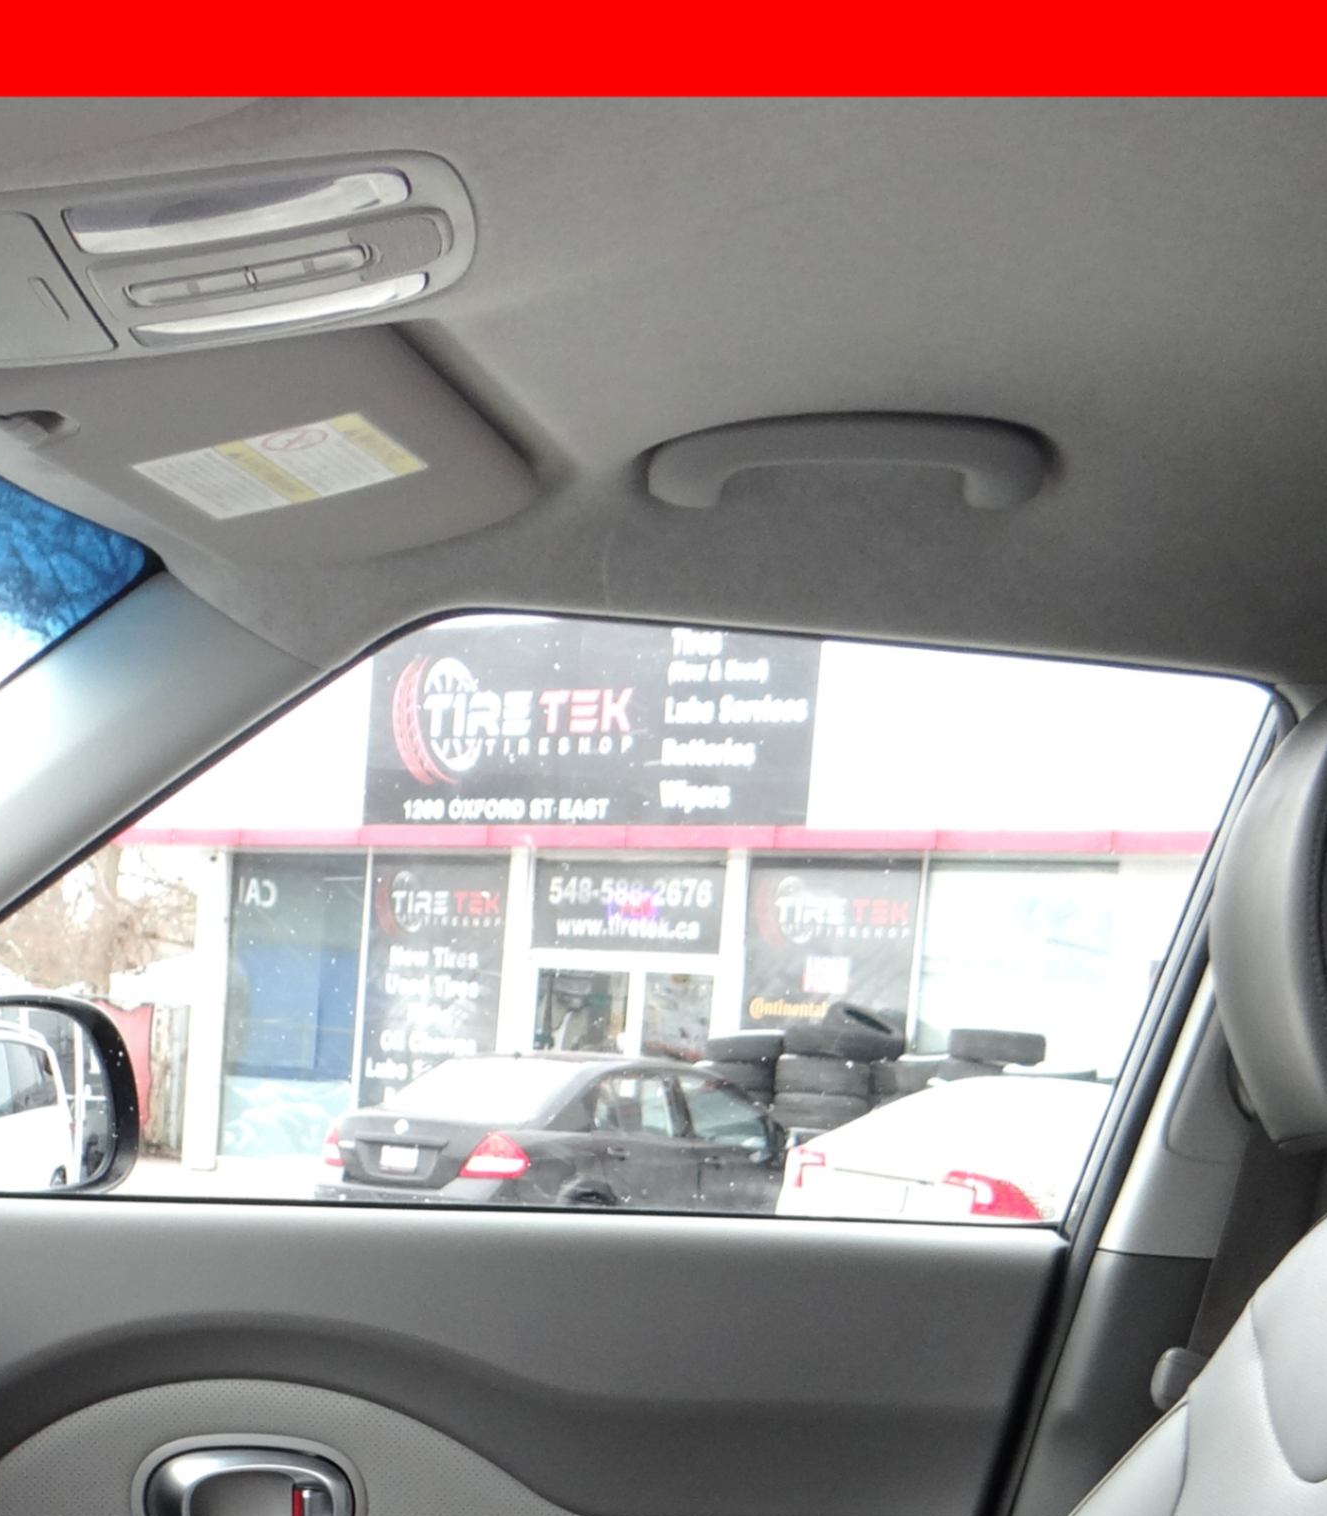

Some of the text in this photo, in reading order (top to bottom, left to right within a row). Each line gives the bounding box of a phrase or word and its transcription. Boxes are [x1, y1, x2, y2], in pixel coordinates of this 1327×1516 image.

[423, 687, 633, 737] TIRE TEK
[664, 694, 808, 724] Lube Services
[660, 737, 756, 766] Batteries
[448, 798, 525, 820] OXFORD
[529, 798, 554, 819] ST
[558, 798, 610, 820] EAST
[659, 779, 731, 814] Wipers
[391, 890, 501, 915] TIRE TEK
[775, 898, 910, 923] TIRE TEK
[556, 915, 700, 941] www.tiretek.ca
[390, 946, 479, 971] New Tires
[385, 974, 429, 997] Used
[365, 1057, 408, 1080] Lube
